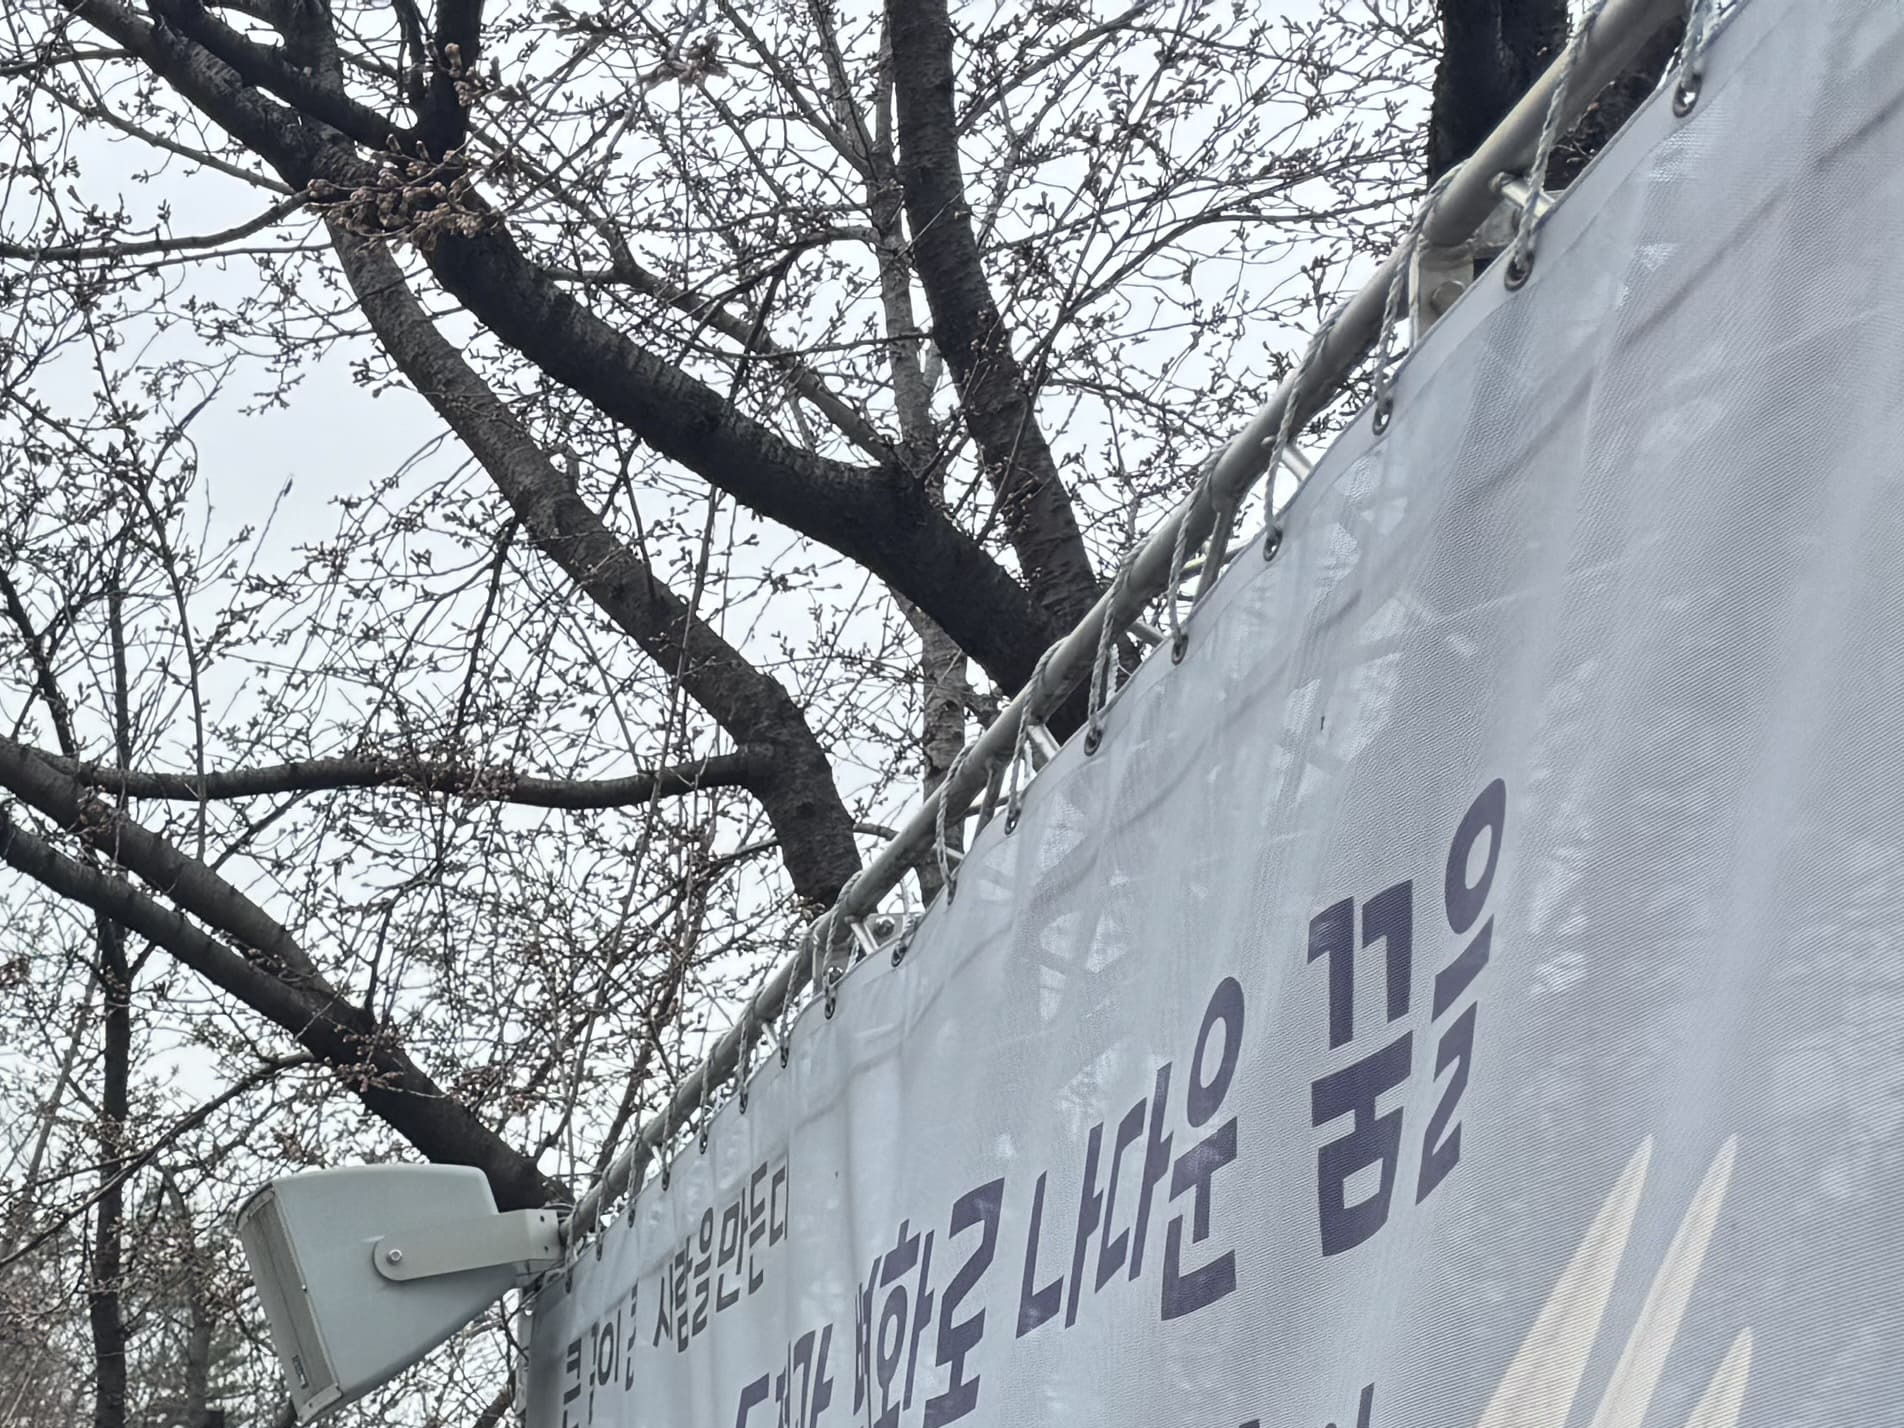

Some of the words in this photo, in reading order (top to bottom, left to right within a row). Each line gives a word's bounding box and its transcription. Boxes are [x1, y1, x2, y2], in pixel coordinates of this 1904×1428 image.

[1015, 974, 1245, 1341] 나다운
[1307, 775, 1509, 1259] 꿈을
[652, 1206, 714, 1354] 사람을
[715, 1160, 789, 1313] 만든다
